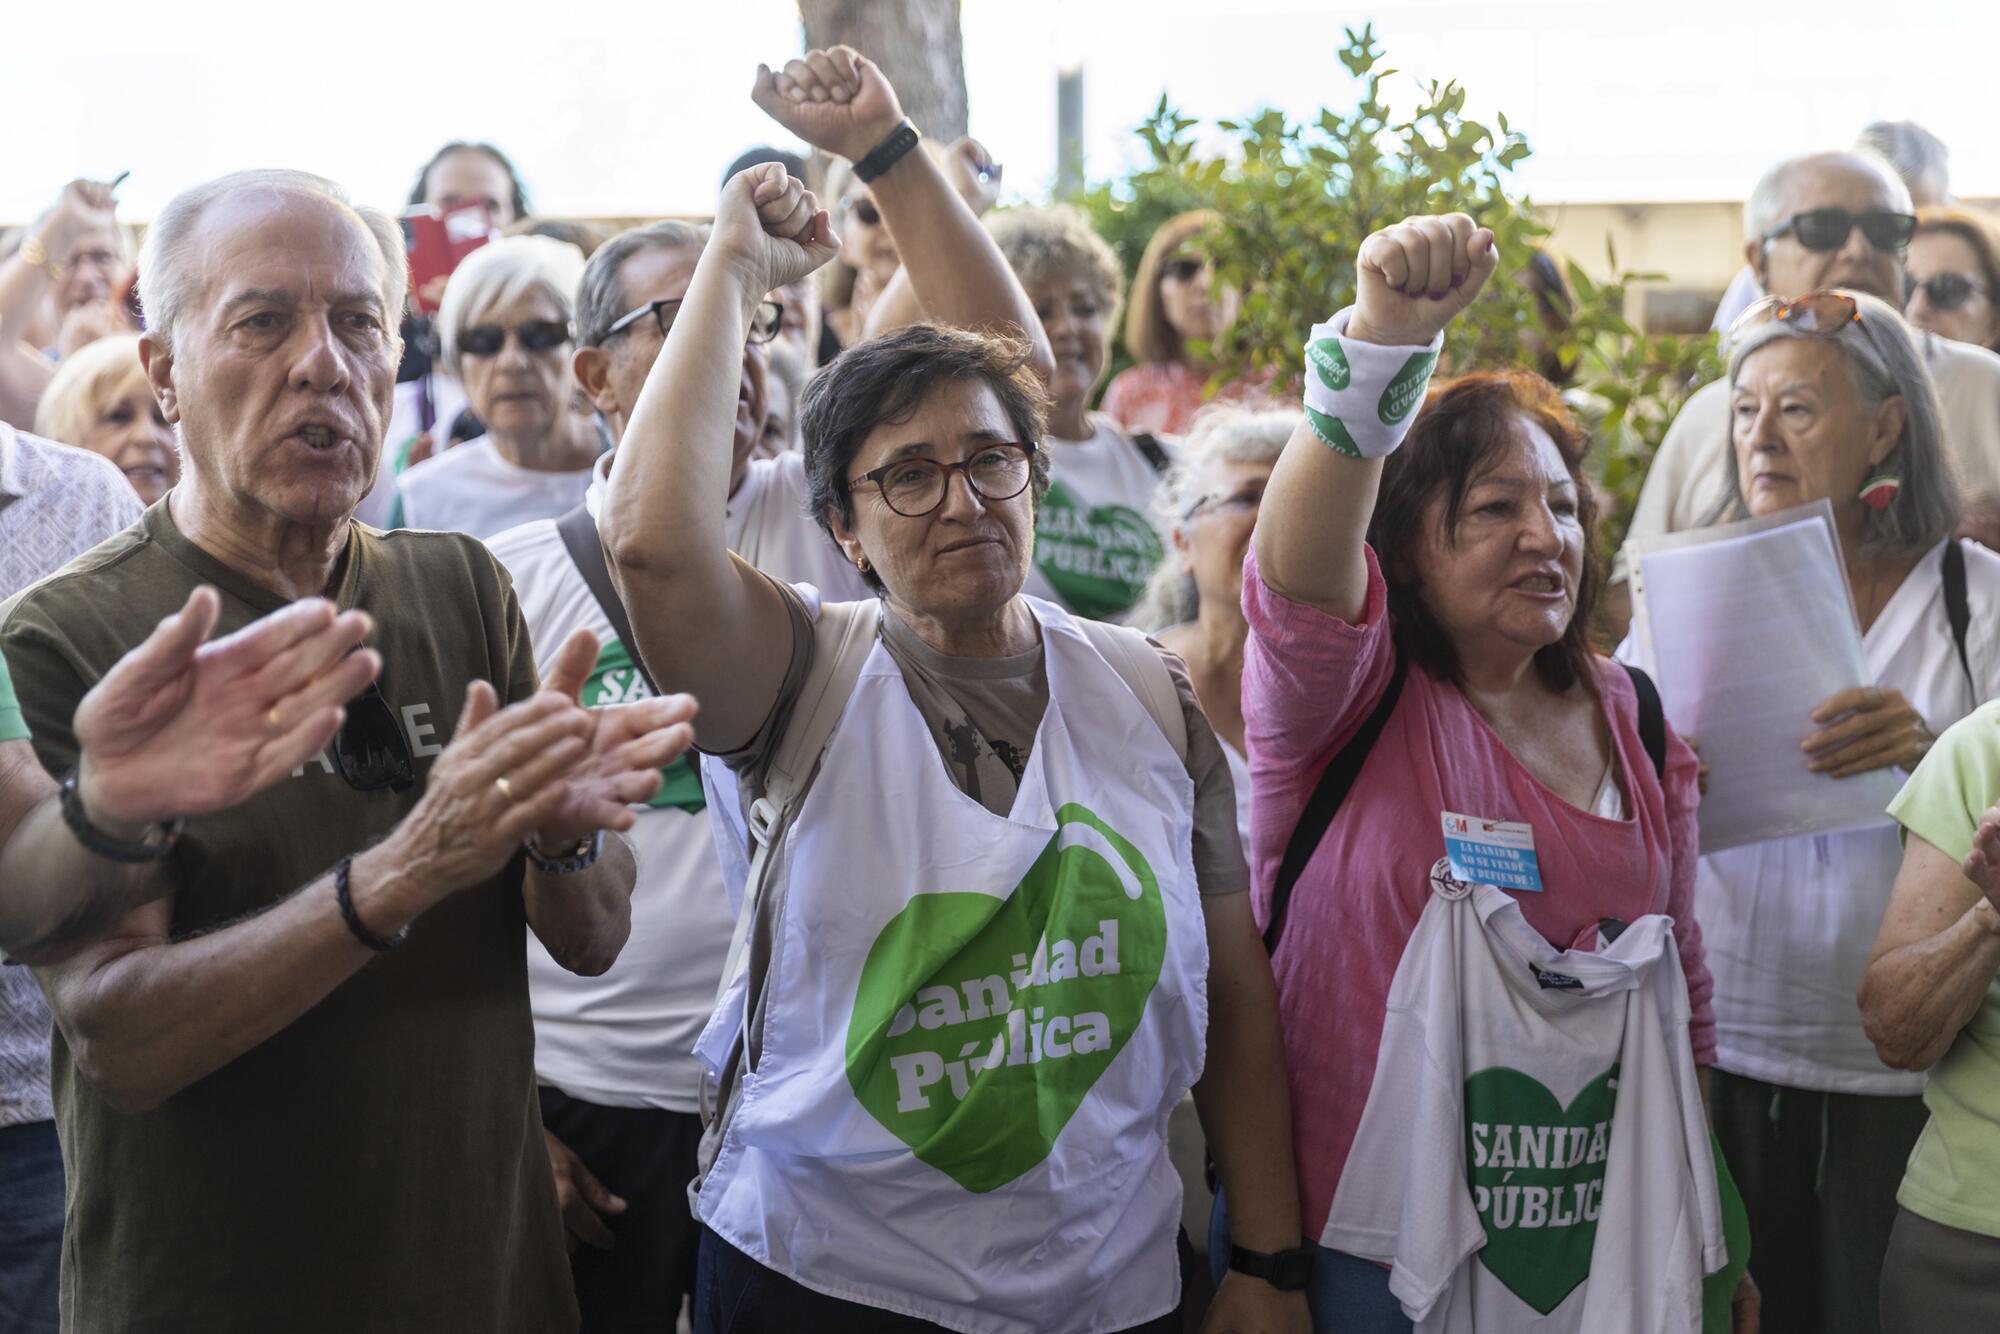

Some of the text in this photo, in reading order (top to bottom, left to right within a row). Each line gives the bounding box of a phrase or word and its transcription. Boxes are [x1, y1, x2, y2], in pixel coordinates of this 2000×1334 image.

[1474, 844, 1520, 860] SANIDAD
[1461, 854, 1475, 865] NO
[1491, 859, 1525, 873] VENDE
[1472, 1120, 1611, 1169] SANIDA
